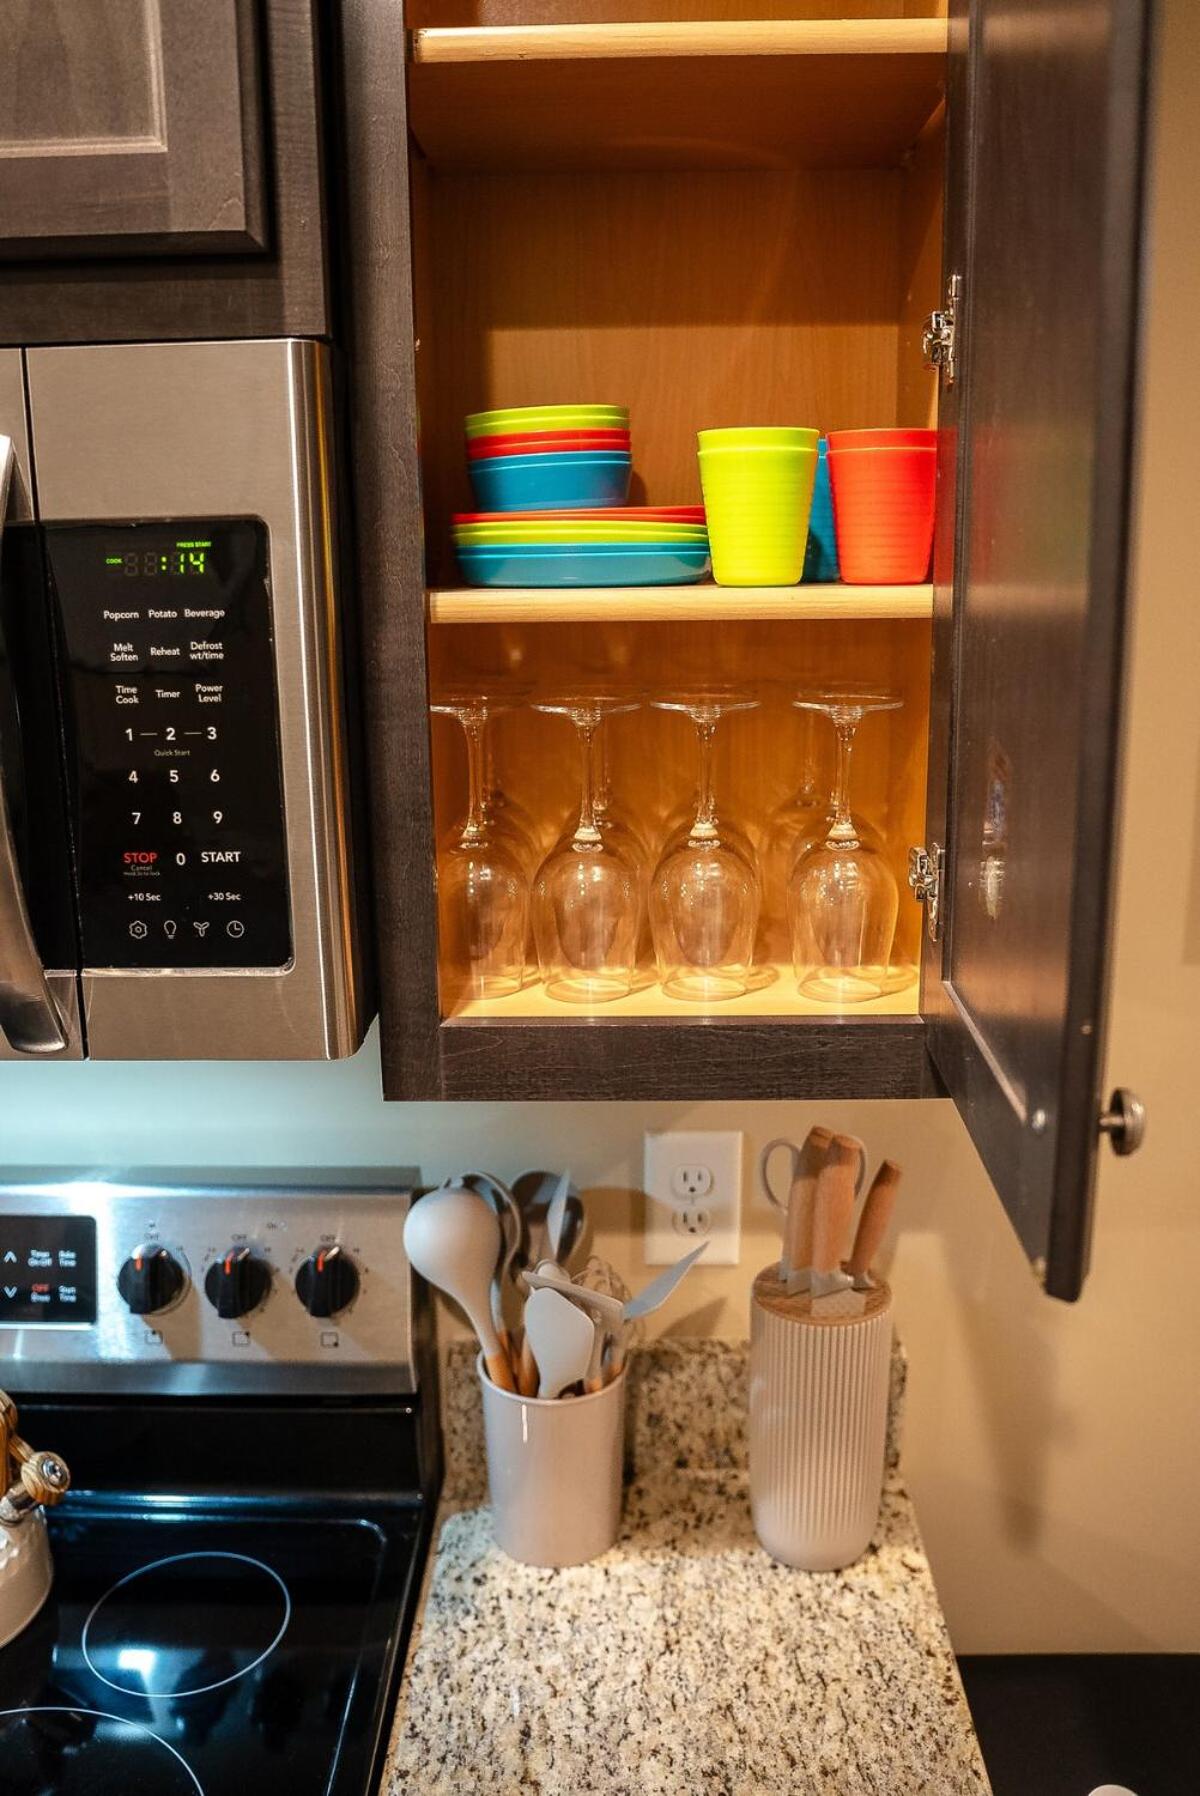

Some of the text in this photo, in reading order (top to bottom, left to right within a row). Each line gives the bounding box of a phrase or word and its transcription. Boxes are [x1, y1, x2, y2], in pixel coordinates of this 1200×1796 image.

[103, 610, 139, 622] Popcorn
[148, 609, 177, 619] Potato
[184, 608, 225, 620] Beverage
[113, 643, 133, 652] Melt
[190, 641, 222, 650] Defrost
[110, 652, 138, 662] Soften
[150, 647, 180, 656] Reheat
[190, 651, 224, 660] wt/time
[115, 685, 137, 694] Time
[195, 683, 223, 692] Power
[155, 689, 180, 698] Timer
[198, 694, 222, 703] Level
[115, 695, 139, 704] Cook
[125, 728, 133, 741] 1
[166, 727, 176, 740] 2
[207, 726, 217, 740] 3
[154, 749, 173, 757] Quick
[128, 770, 138, 783] 4
[169, 769, 179, 783] 5
[210, 769, 220, 782] 6
[131, 812, 141, 825] 7
[172, 811, 182, 824] 8
[213, 811, 223, 823] 9
[123, 852, 158, 864] STOP
[176, 852, 186, 866] 0
[201, 851, 241, 863] START
[128, 892, 161, 901] +10 Sec
[208, 891, 241, 901] +30 Sec
